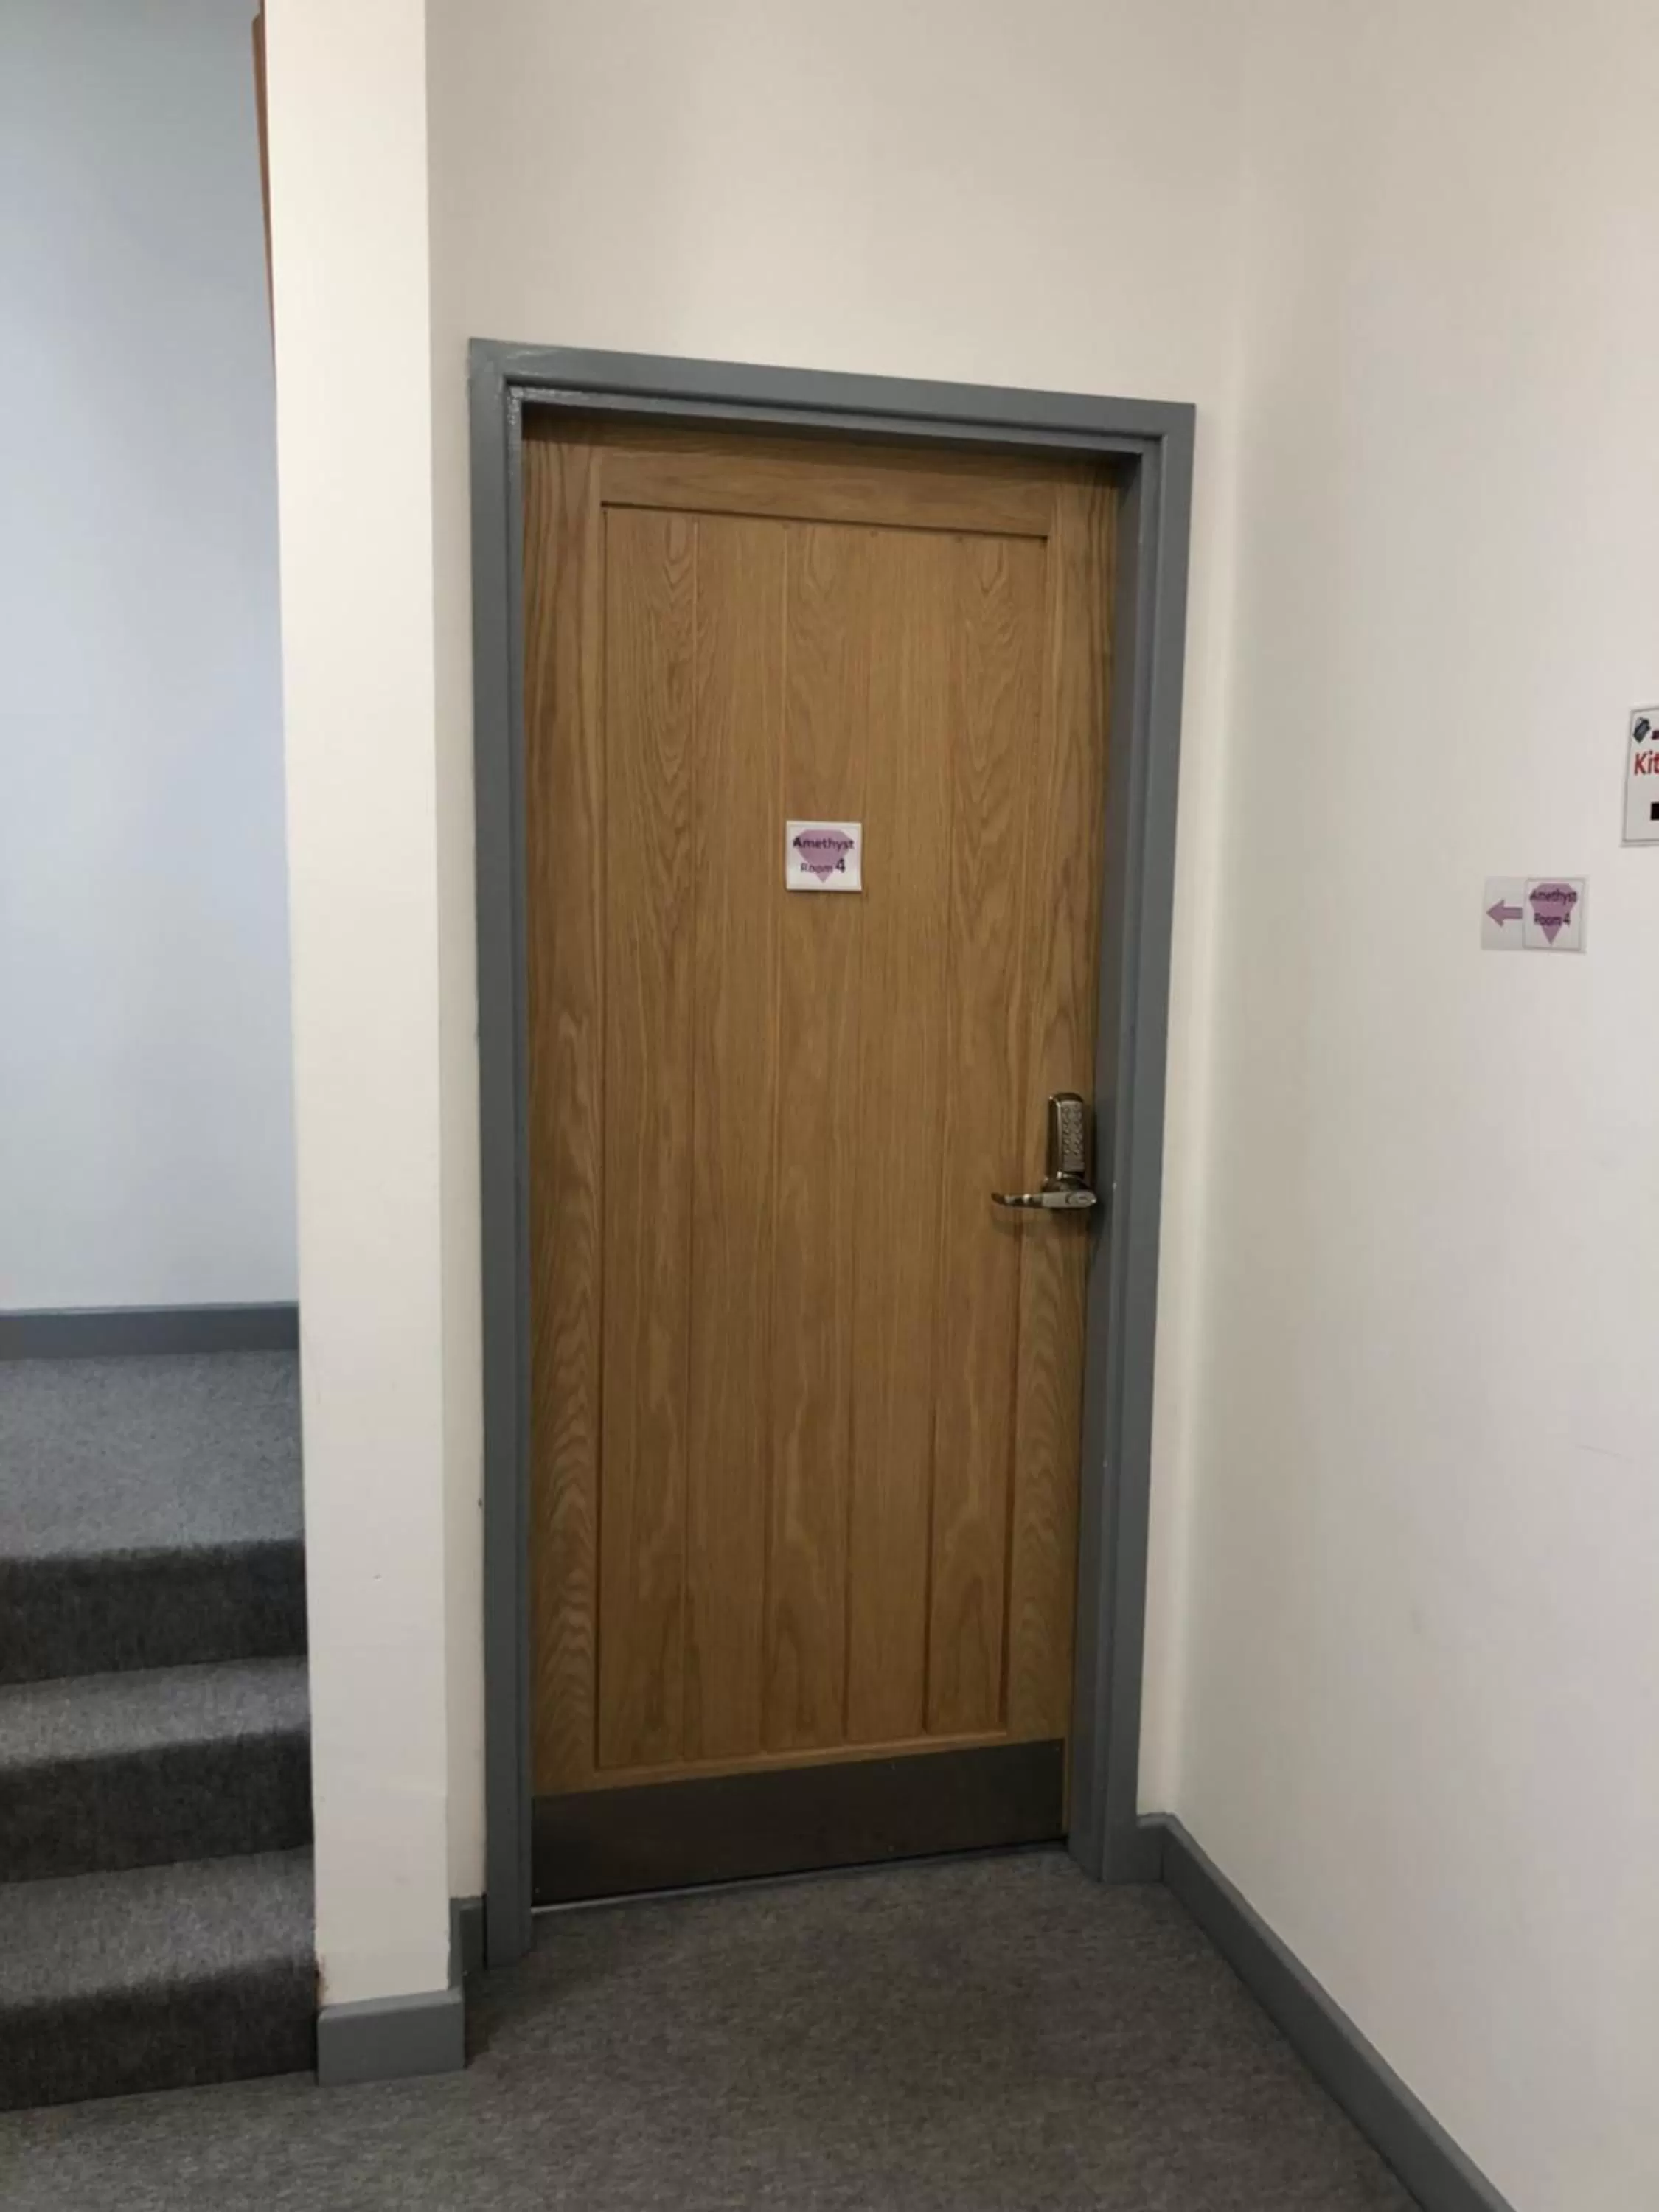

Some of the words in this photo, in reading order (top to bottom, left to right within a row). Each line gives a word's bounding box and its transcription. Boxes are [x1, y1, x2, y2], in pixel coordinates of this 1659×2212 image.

[793, 837, 855, 852] Amethyst
[800, 863, 832, 873] Room
[835, 858, 846, 873] 4
